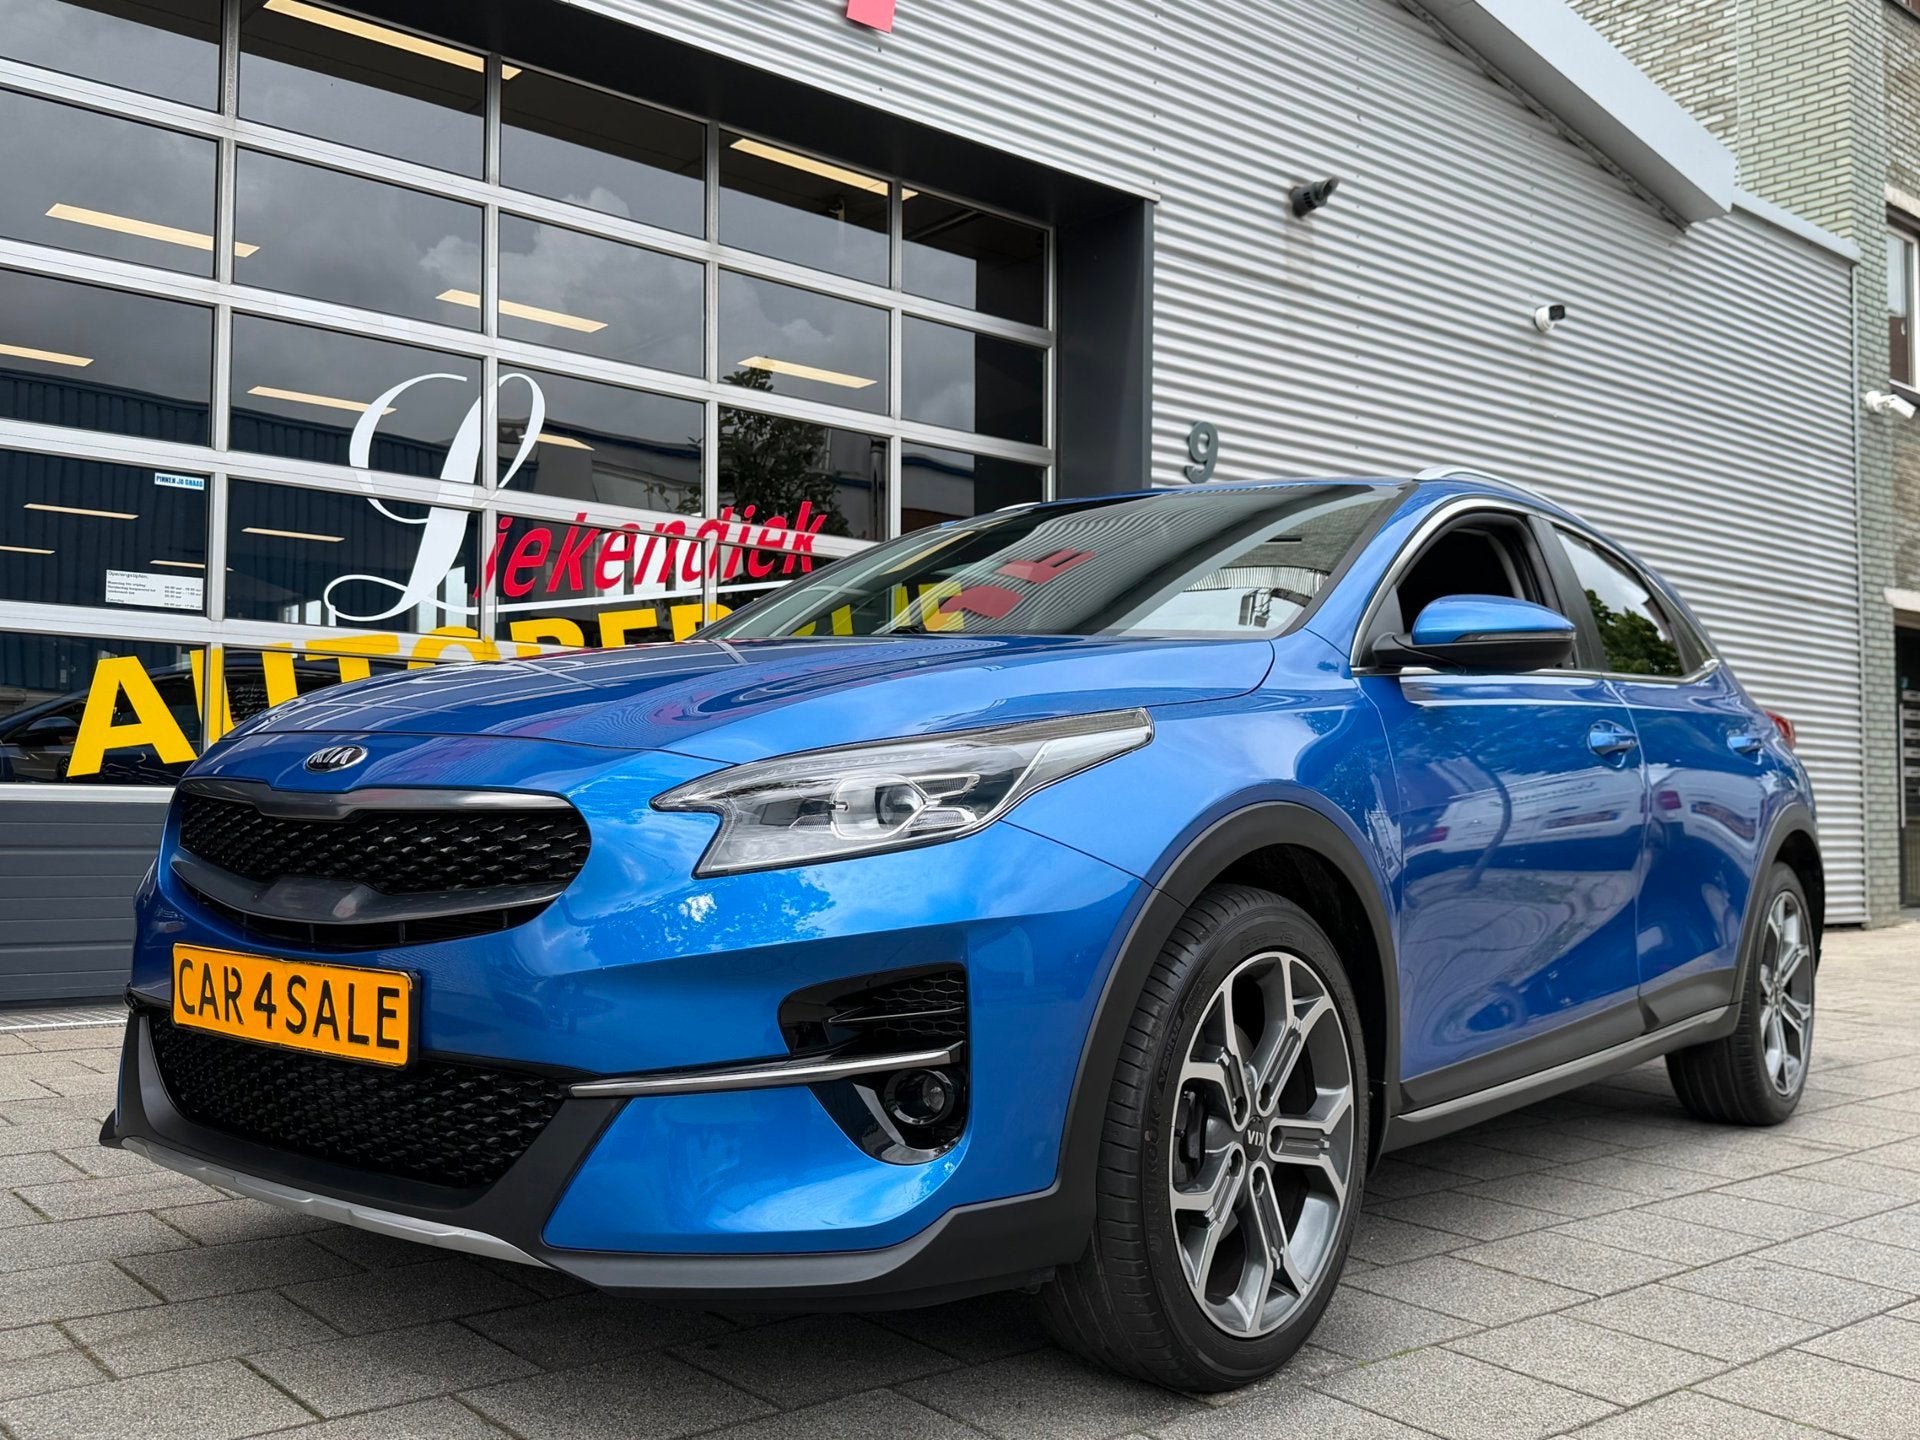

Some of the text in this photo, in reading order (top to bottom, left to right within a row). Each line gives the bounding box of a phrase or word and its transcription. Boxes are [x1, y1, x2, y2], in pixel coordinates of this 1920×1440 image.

[1184, 421, 1218, 484] 9
[308, 746, 358, 766] KIA
[178, 958, 401, 1050] CAR 4 SALE
[1246, 1129, 1265, 1147] KIA
